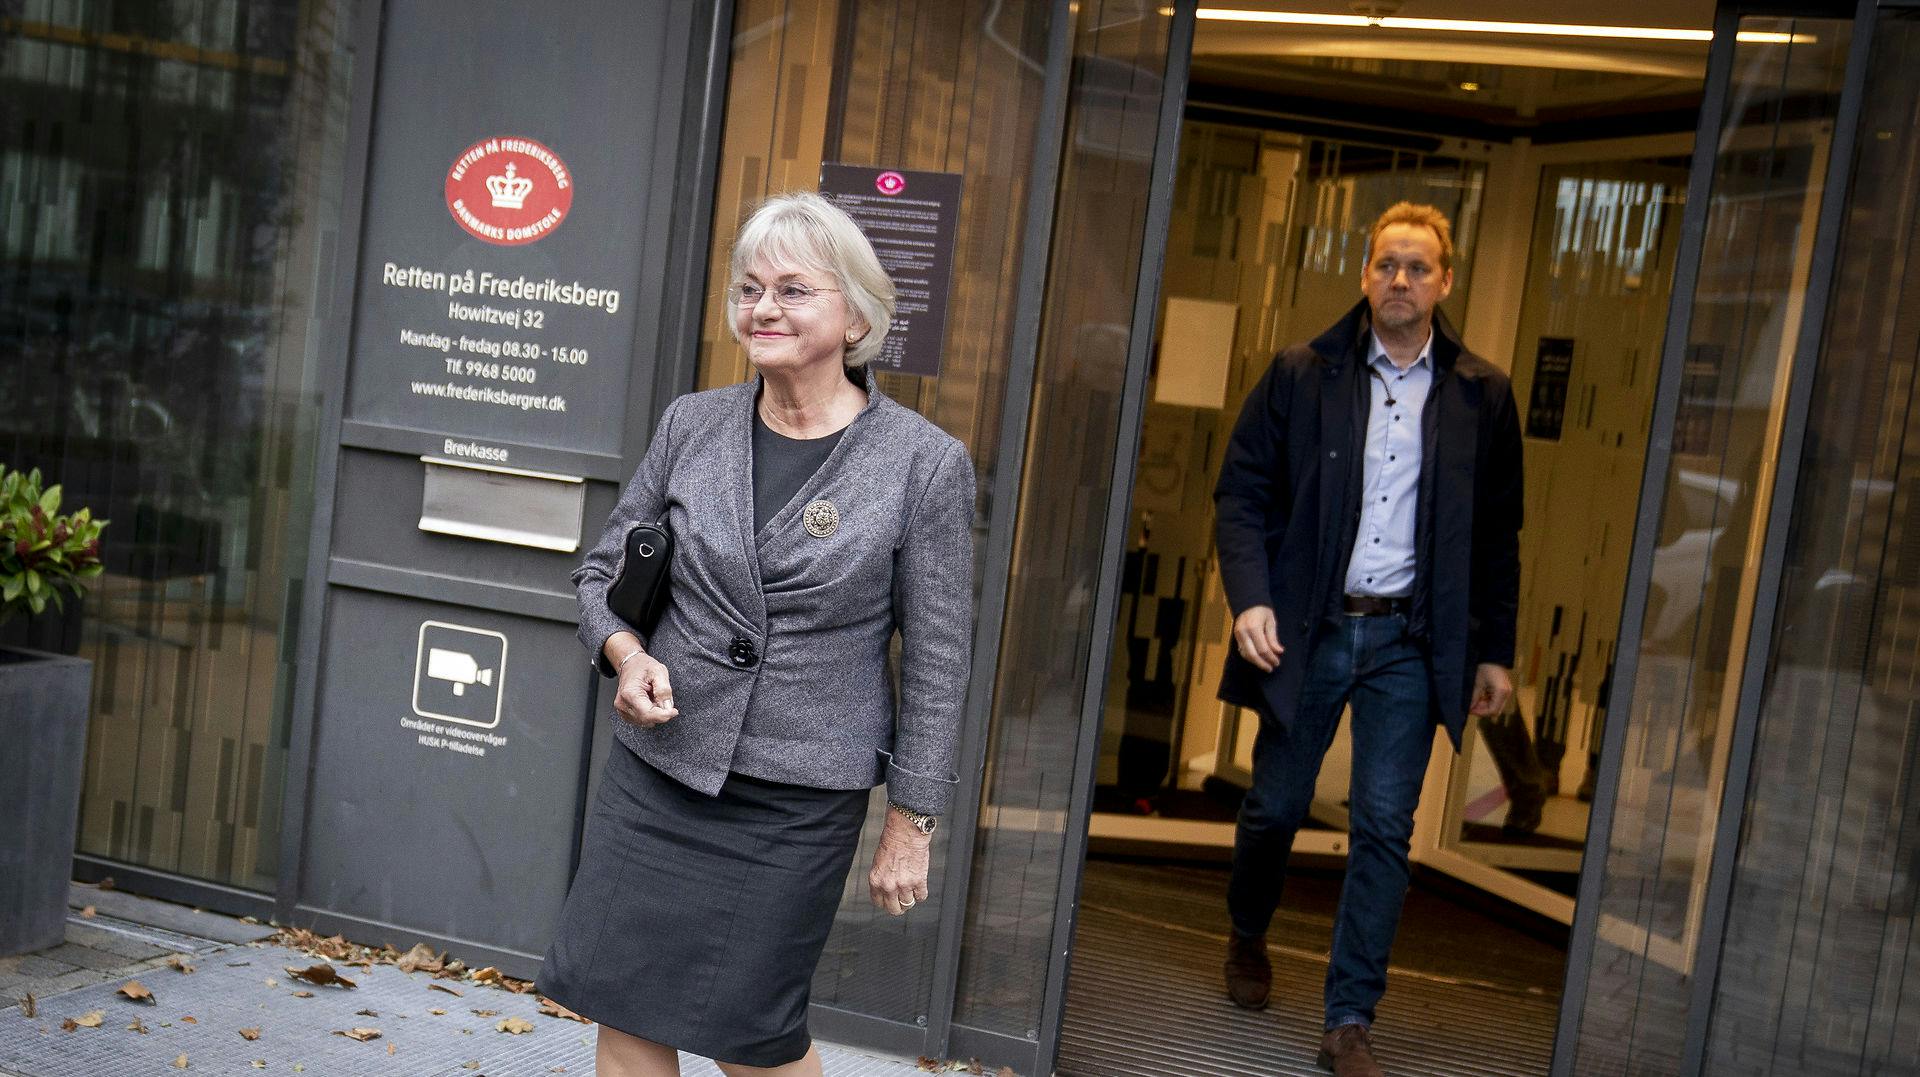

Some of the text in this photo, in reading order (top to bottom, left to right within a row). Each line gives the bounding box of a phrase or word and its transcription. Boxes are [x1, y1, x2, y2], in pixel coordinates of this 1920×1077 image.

[451, 138, 569, 189] RETTEN PÅ FREDERIKSBERG
[453, 198, 561, 240] DANMARKS DOMSTOLE
[383, 262, 620, 314] Retten på Frederiksberg
[448, 301, 545, 330] Howitzvej 32
[400, 328, 451, 352] Mandag
[459, 335, 501, 358] fredag
[502, 340, 541, 360] 08.30
[551, 346, 588, 365] 15.00
[445, 358, 537, 383] Tlf. 9968 5000
[411, 381, 568, 412] www.frederiksbergret.dk
[443, 438, 509, 462] Brevkasse
[400, 716, 435, 733] Området
[435, 725, 445, 735] er
[418, 735, 440, 748] HUSK
